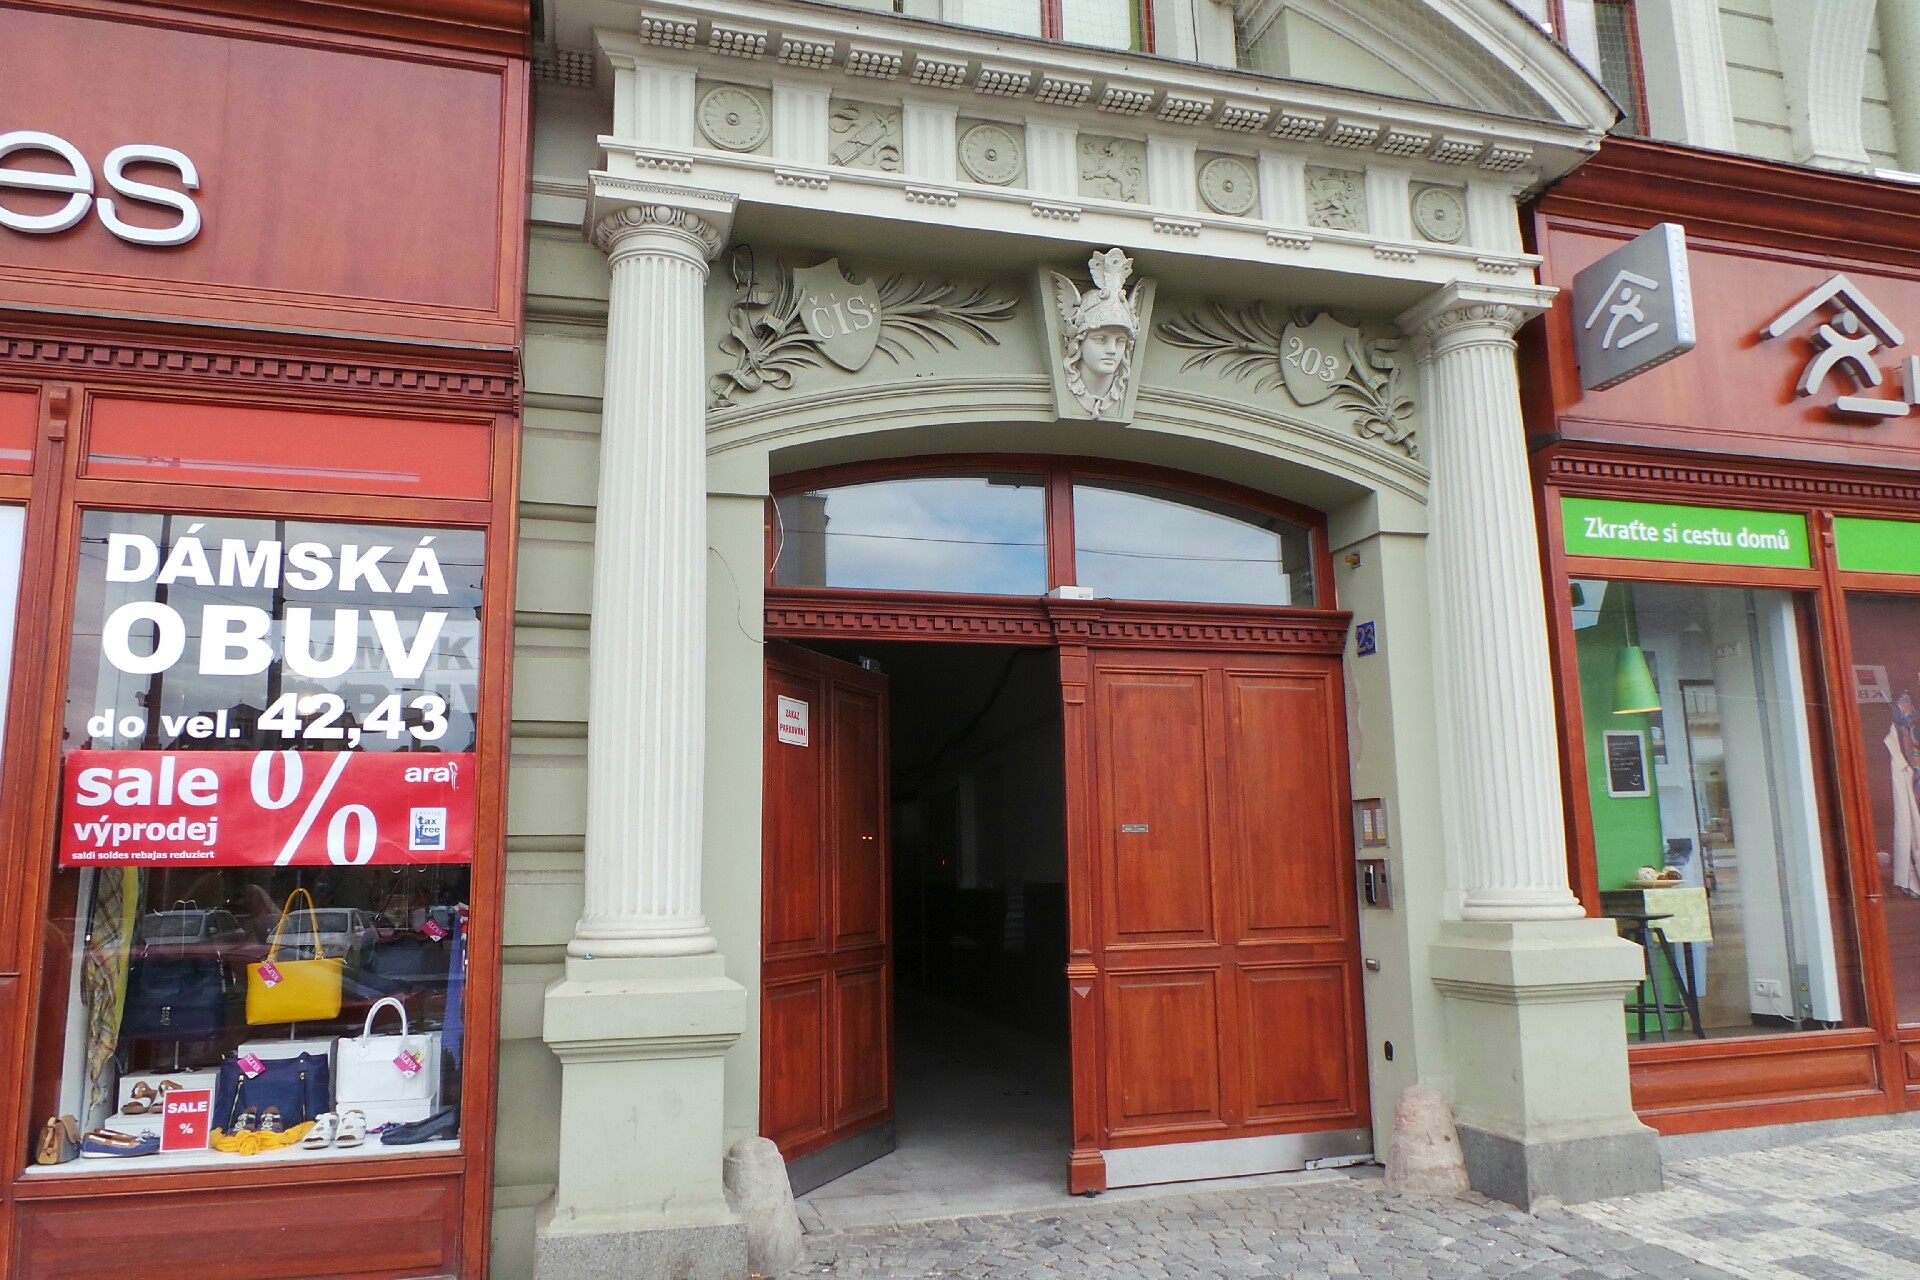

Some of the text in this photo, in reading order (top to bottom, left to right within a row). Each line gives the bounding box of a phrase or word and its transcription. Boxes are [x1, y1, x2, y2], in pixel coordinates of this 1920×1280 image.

[0, 130, 201, 247] es
[1285, 336, 1339, 382] 203
[1584, 517, 1790, 550] Zkraťte si cestu domů
[106, 524, 449, 595] DÁMSKÁ
[102, 601, 449, 680] OBUV
[1355, 625, 1375, 652] 23
[87, 692, 449, 748] do vel. 42,43
[76, 756, 219, 806] sale
[404, 767, 450, 782] ara
[250, 750, 378, 866] %
[418, 816, 437, 825] tax
[73, 814, 218, 847] výprodej
[419, 825, 440, 837] free
[72, 850, 215, 861] saldi soldes rebajas reduziert
[244, 1054, 261, 1072] SLEVA
[399, 1052, 416, 1071] SLEVA
[167, 1101, 208, 1114] SALE
[179, 1122, 194, 1134] %
